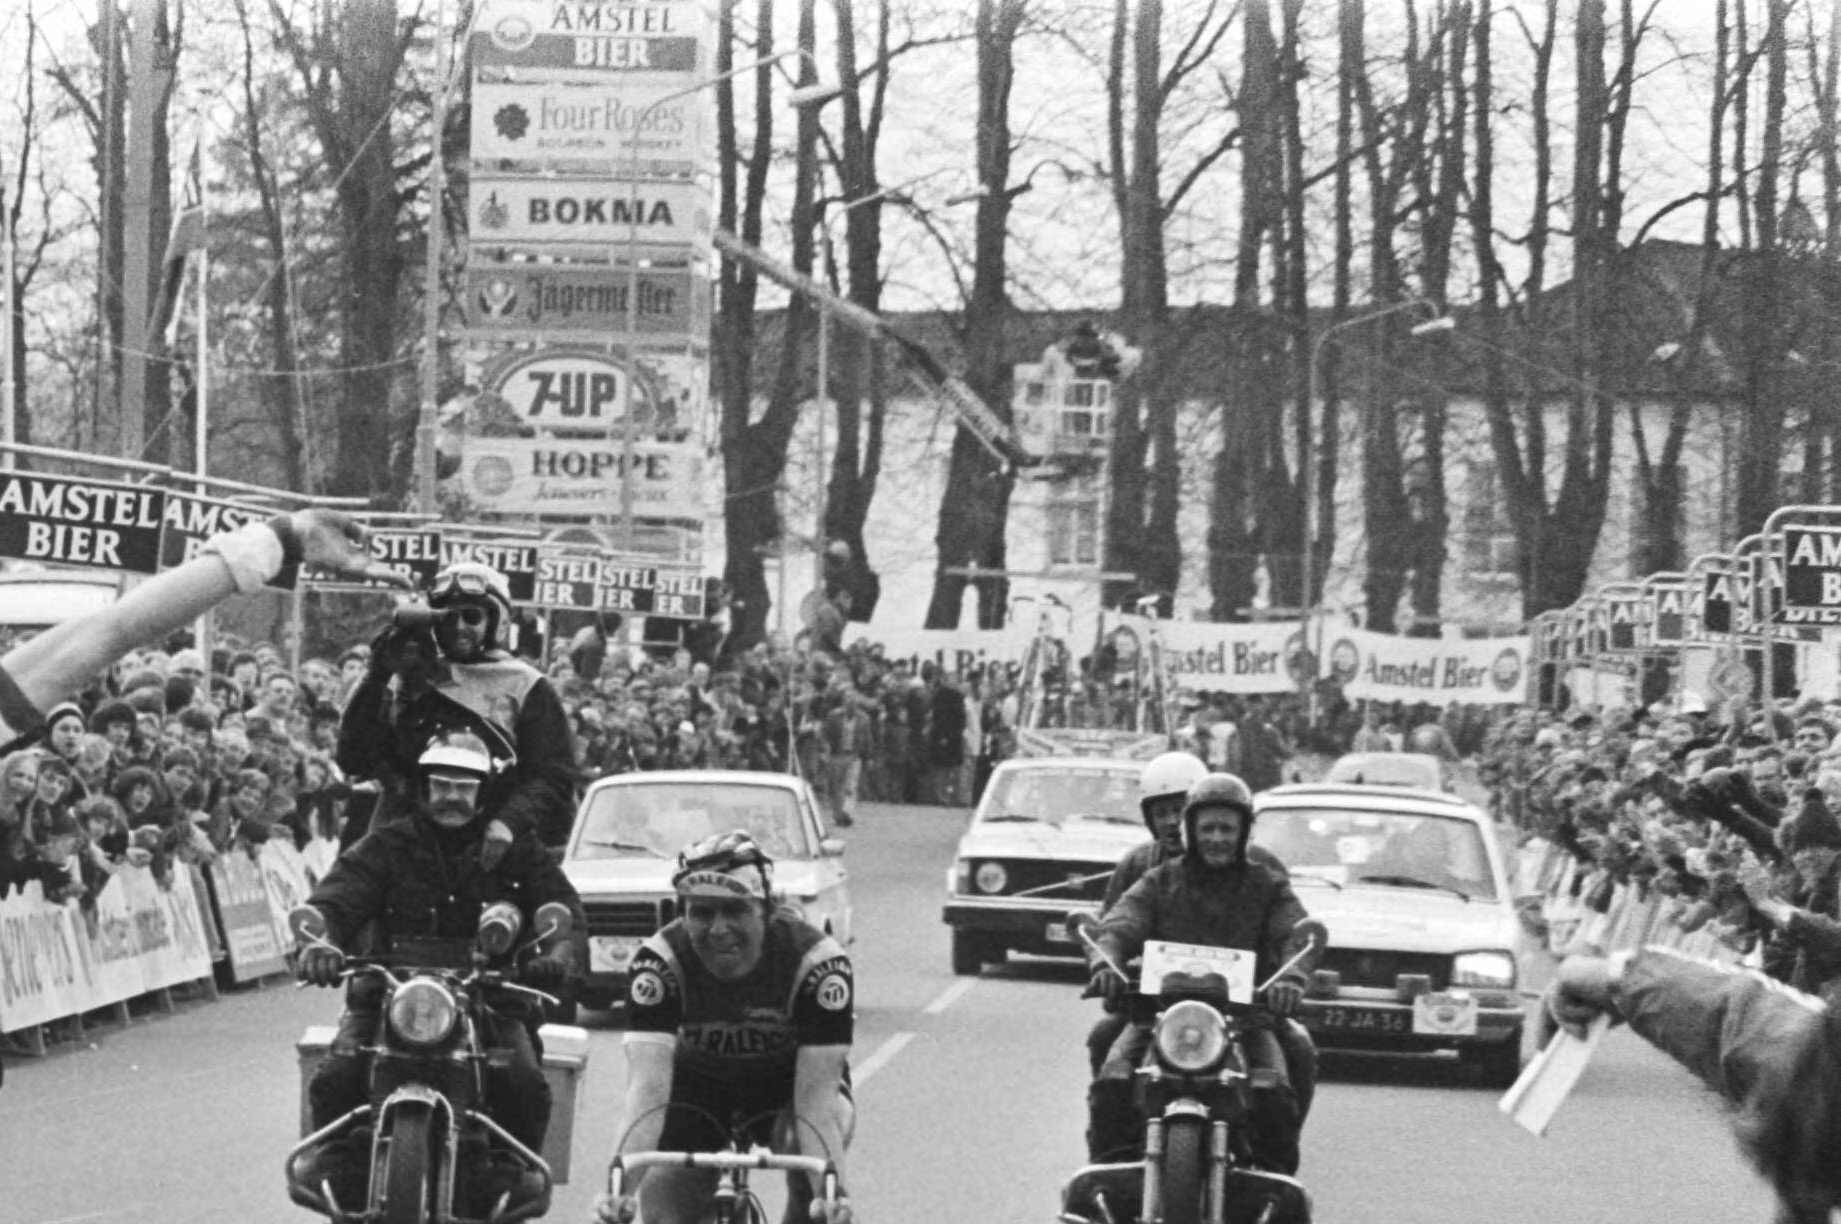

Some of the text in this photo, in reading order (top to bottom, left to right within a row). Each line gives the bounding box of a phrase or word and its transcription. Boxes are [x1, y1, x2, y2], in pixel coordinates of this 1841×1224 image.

[550, 6, 677, 33] AMSTEL
[574, 37, 650, 67] BIER
[539, 97, 684, 133] Four Roses
[528, 198, 674, 226] BOKMA
[532, 449, 671, 480] HOPPE
[164, 497, 257, 536] AMS
[25, 523, 122, 566] BIER
[370, 534, 440, 561] STEL
[538, 559, 596, 583] STEL
[603, 567, 655, 590] STEL
[657, 577, 703, 594] STEL
[533, 582, 574, 606] IER
[1233, 640, 1280, 675] Bier
[1364, 653, 1487, 688] Amstel Bier
